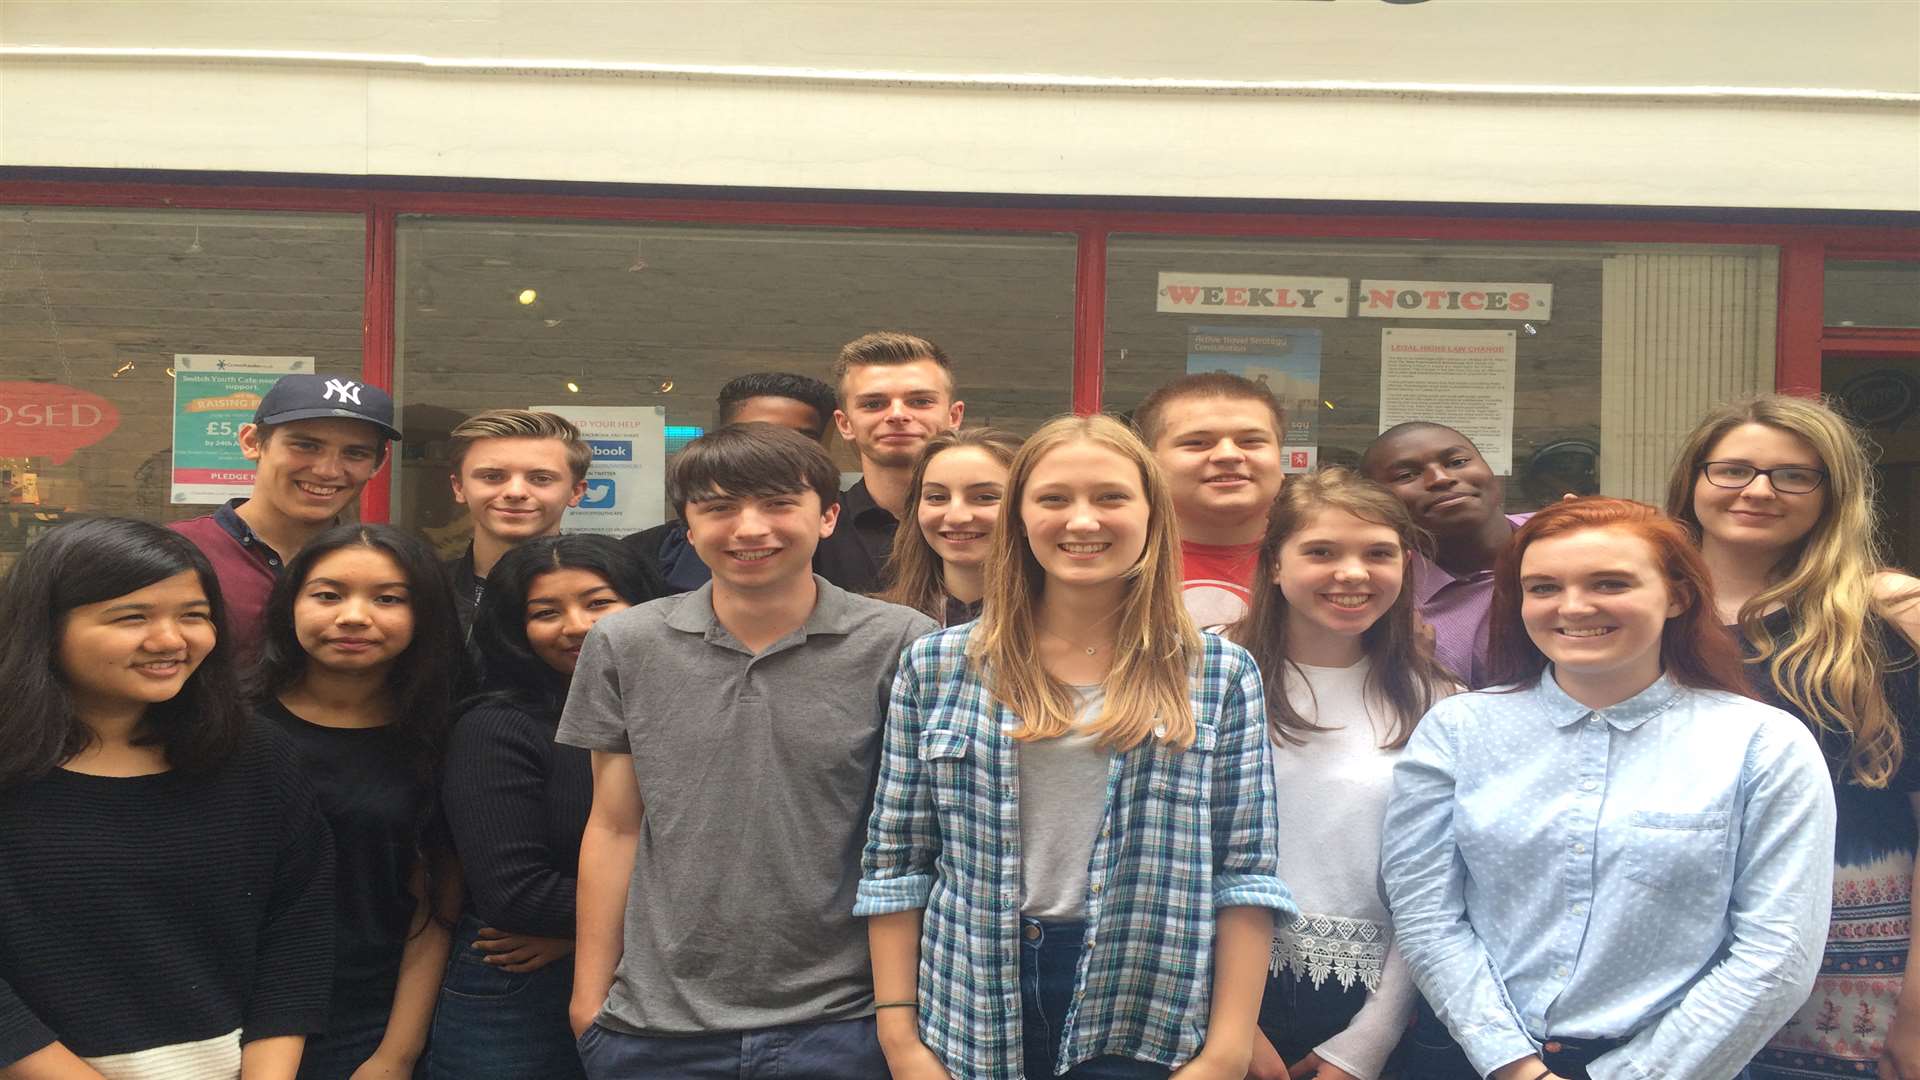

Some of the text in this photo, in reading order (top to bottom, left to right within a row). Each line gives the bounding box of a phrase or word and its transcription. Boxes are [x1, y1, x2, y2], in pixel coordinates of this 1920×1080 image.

[1167, 285, 1530, 311] WEEKLY NOTICES
[323, 378, 361, 405] NY
[206, 421, 239, 439] £5,
[619, 420, 641, 429] HELP
[592, 446, 626, 456] book
[211, 472, 249, 480] PLEDGE
